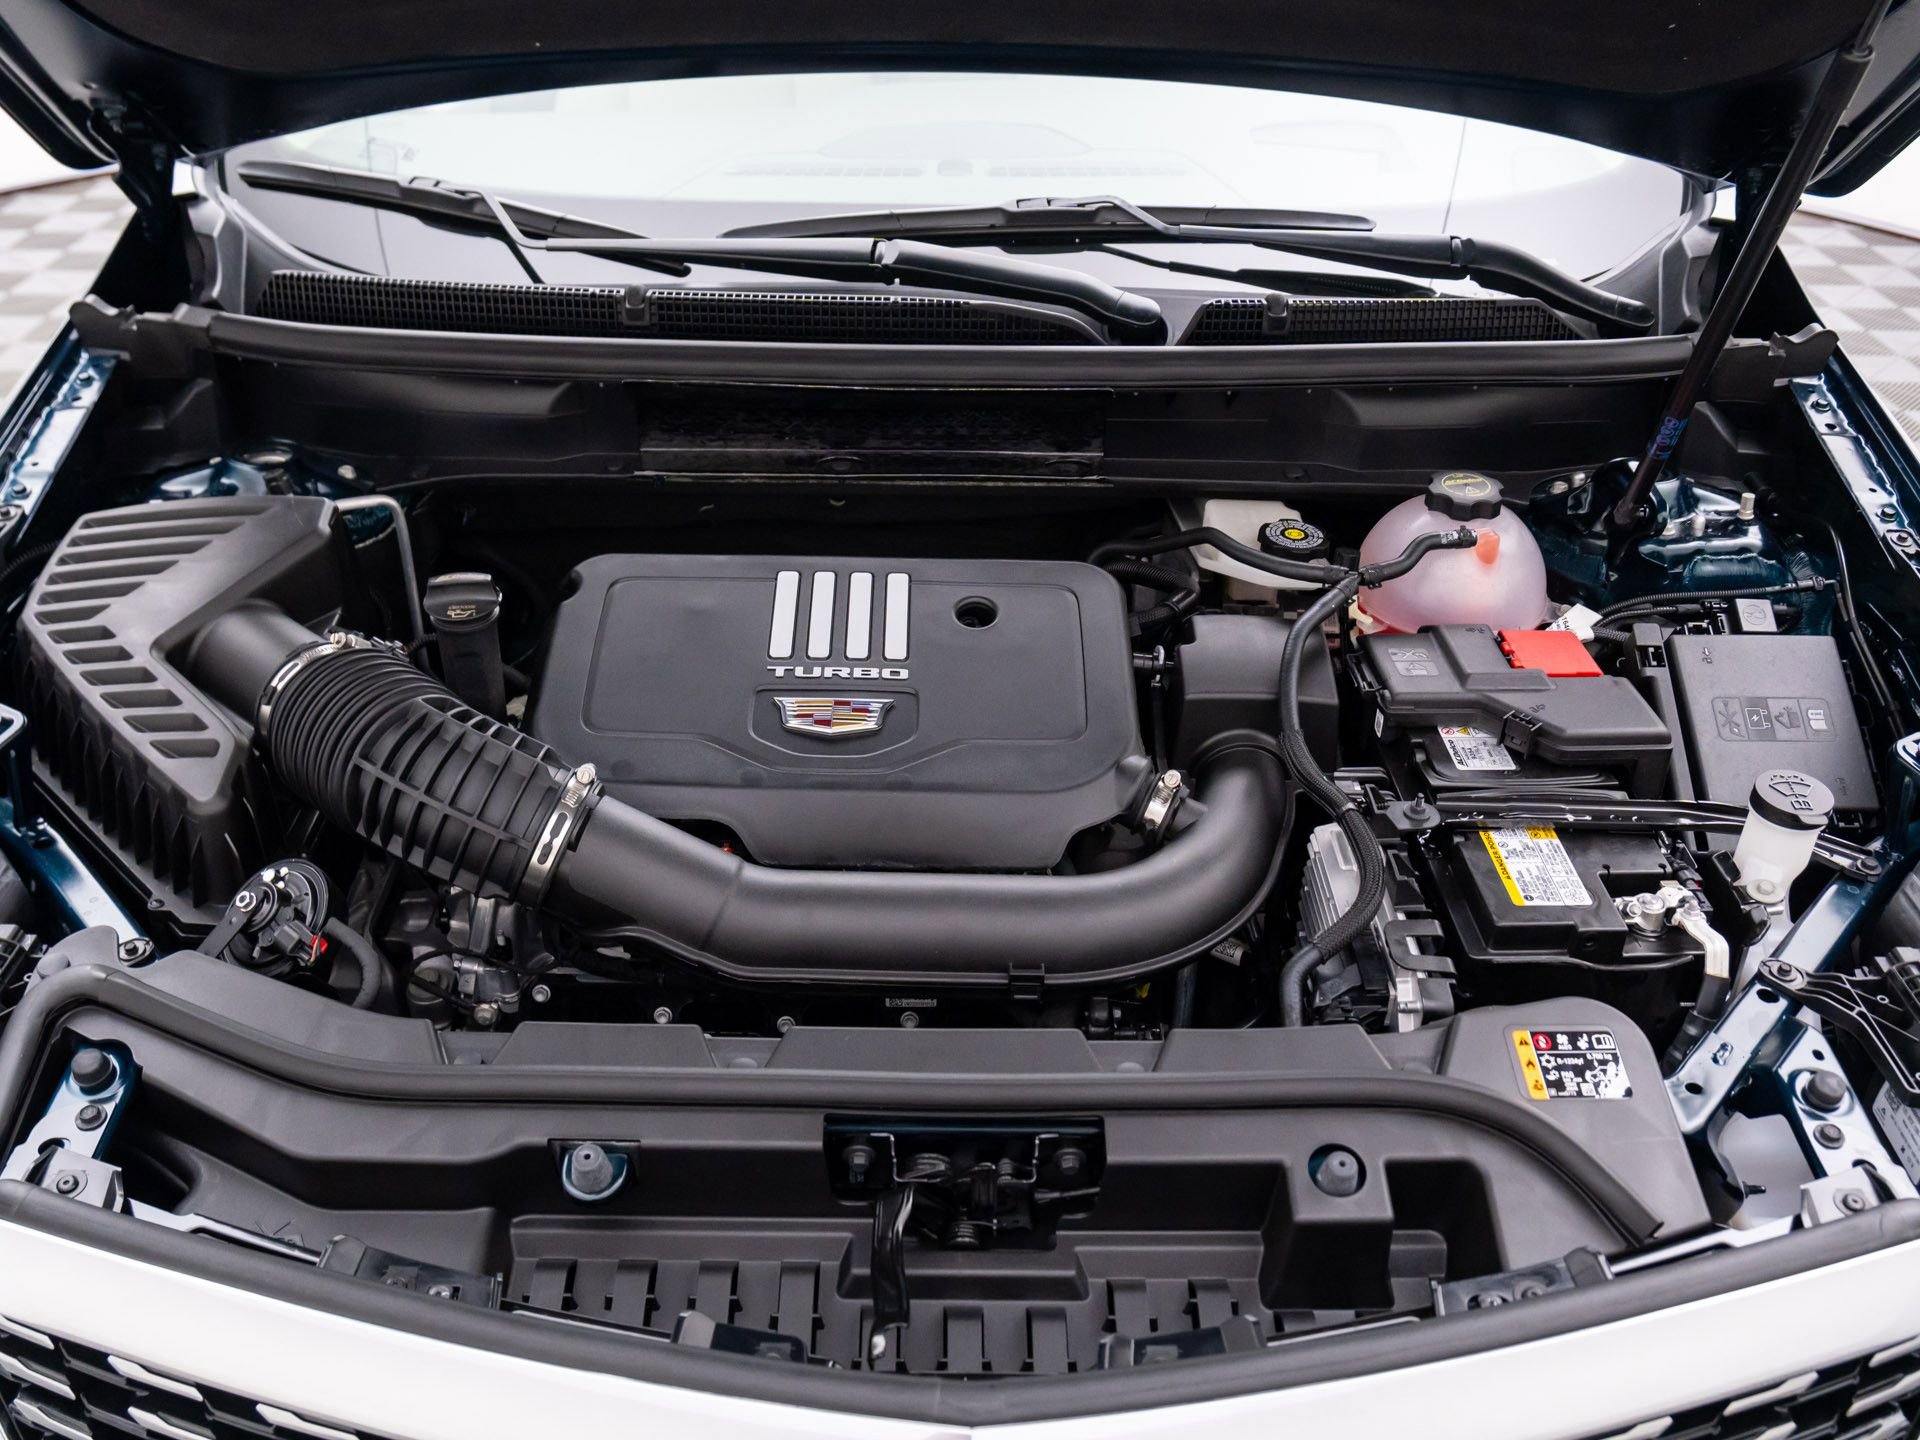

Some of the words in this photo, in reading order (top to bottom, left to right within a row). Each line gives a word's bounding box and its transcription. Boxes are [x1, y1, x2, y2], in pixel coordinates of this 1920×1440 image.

[767, 666, 909, 680] TURBO
[1483, 831, 1496, 850] POISO
[1493, 851, 1510, 876] DANGER
